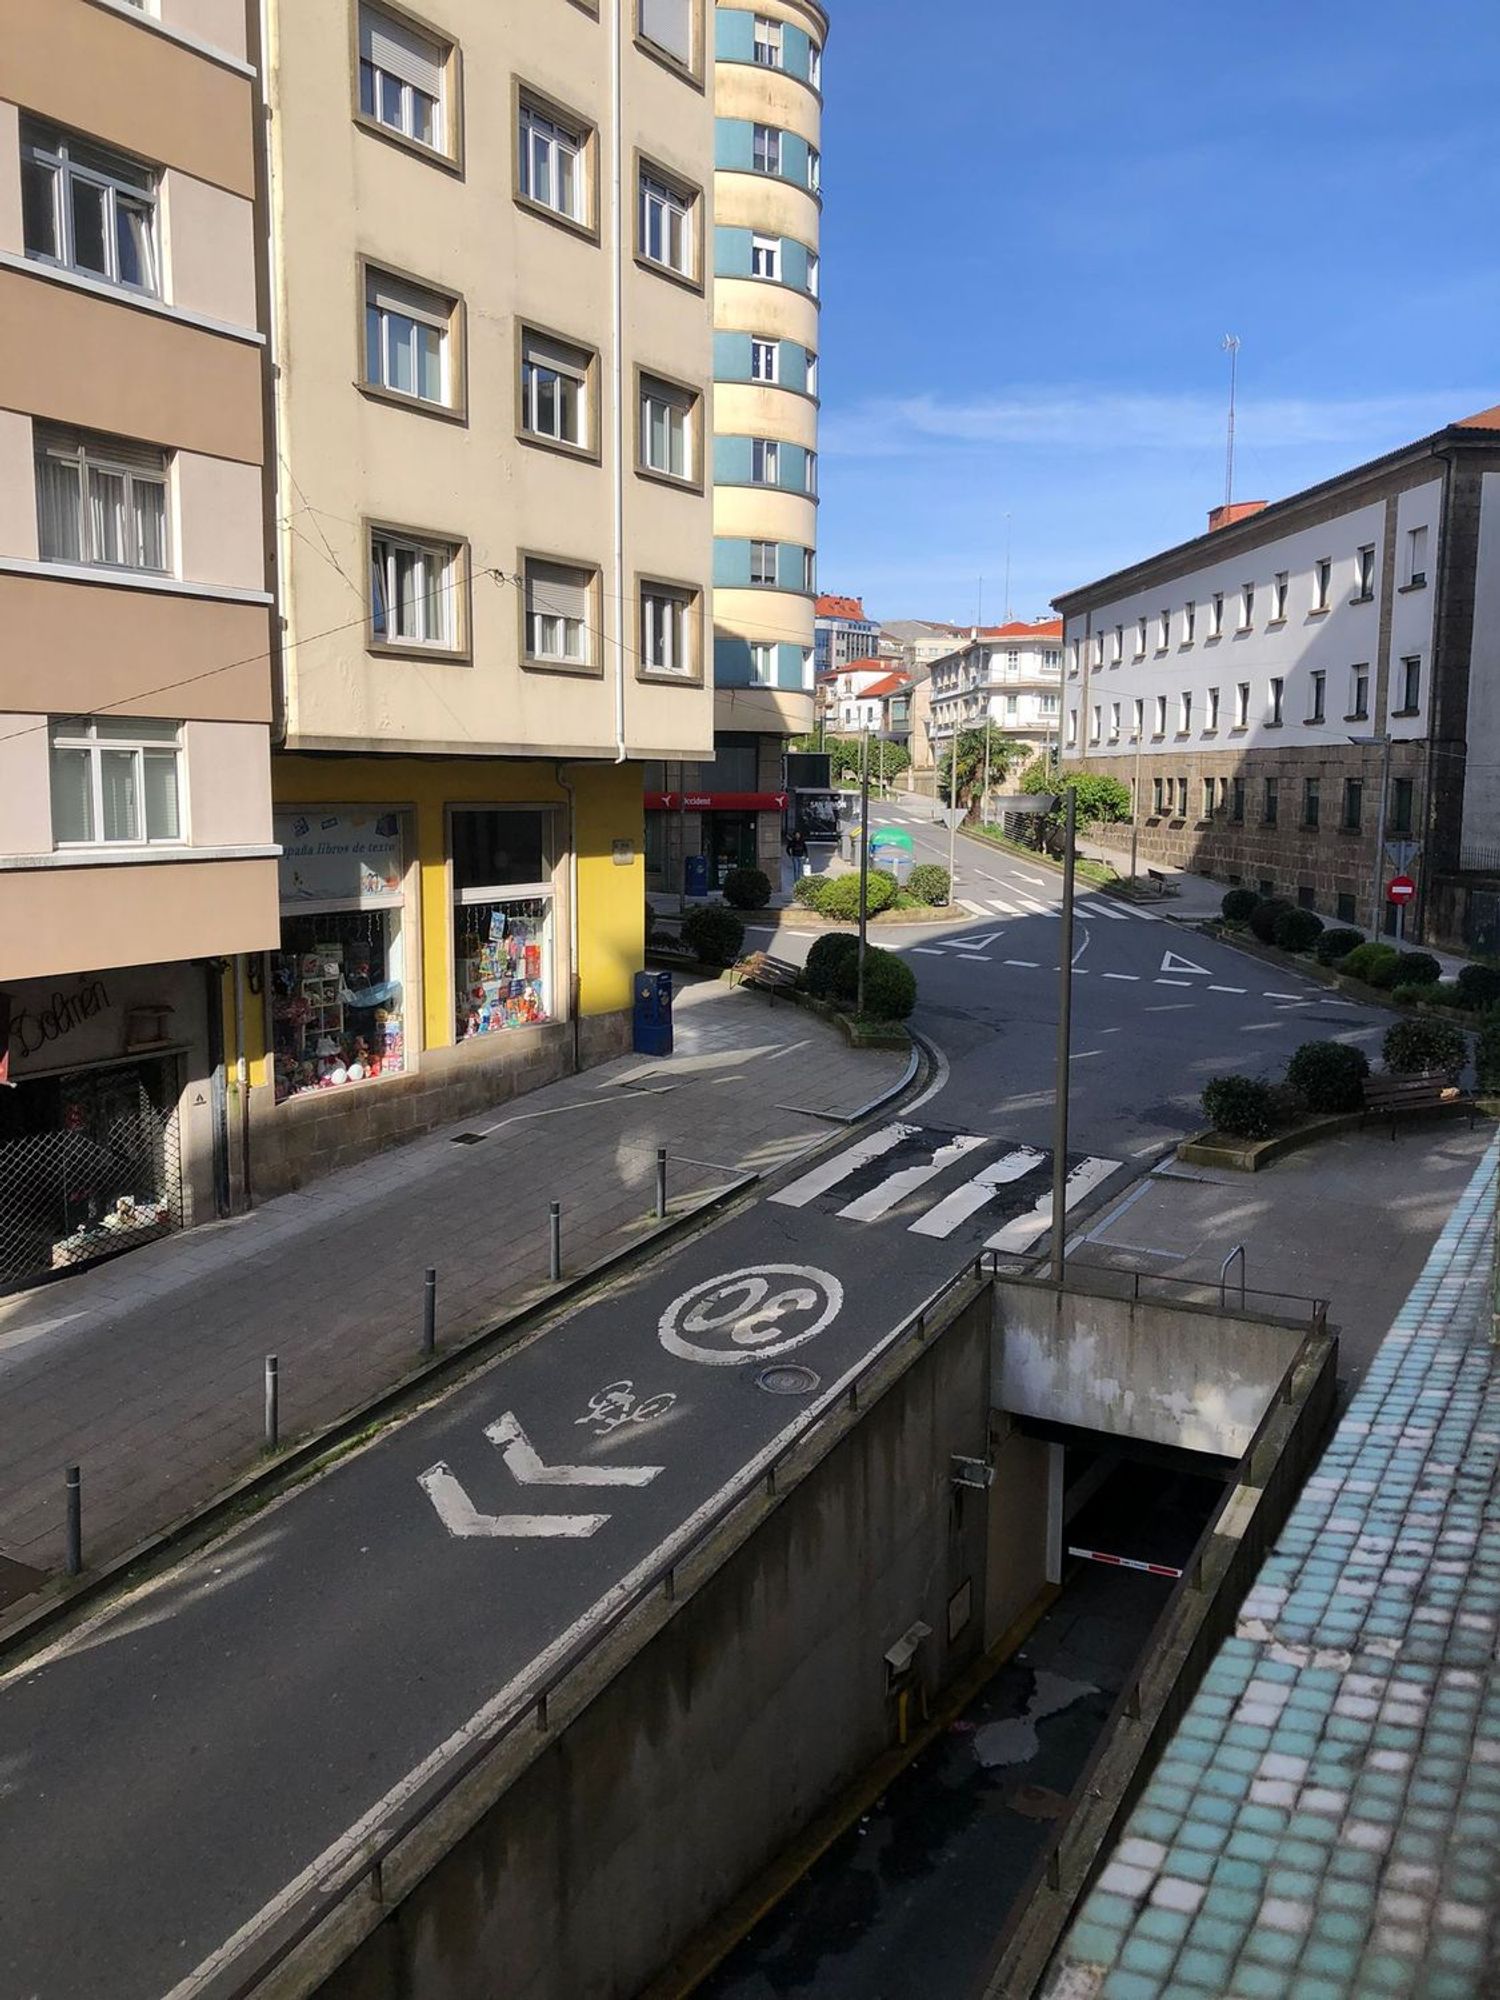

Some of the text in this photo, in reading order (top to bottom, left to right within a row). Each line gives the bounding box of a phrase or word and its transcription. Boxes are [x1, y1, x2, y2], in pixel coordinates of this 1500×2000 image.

[282, 841, 396, 859] paña libros de texto
[682, 1276, 818, 1344] 30
